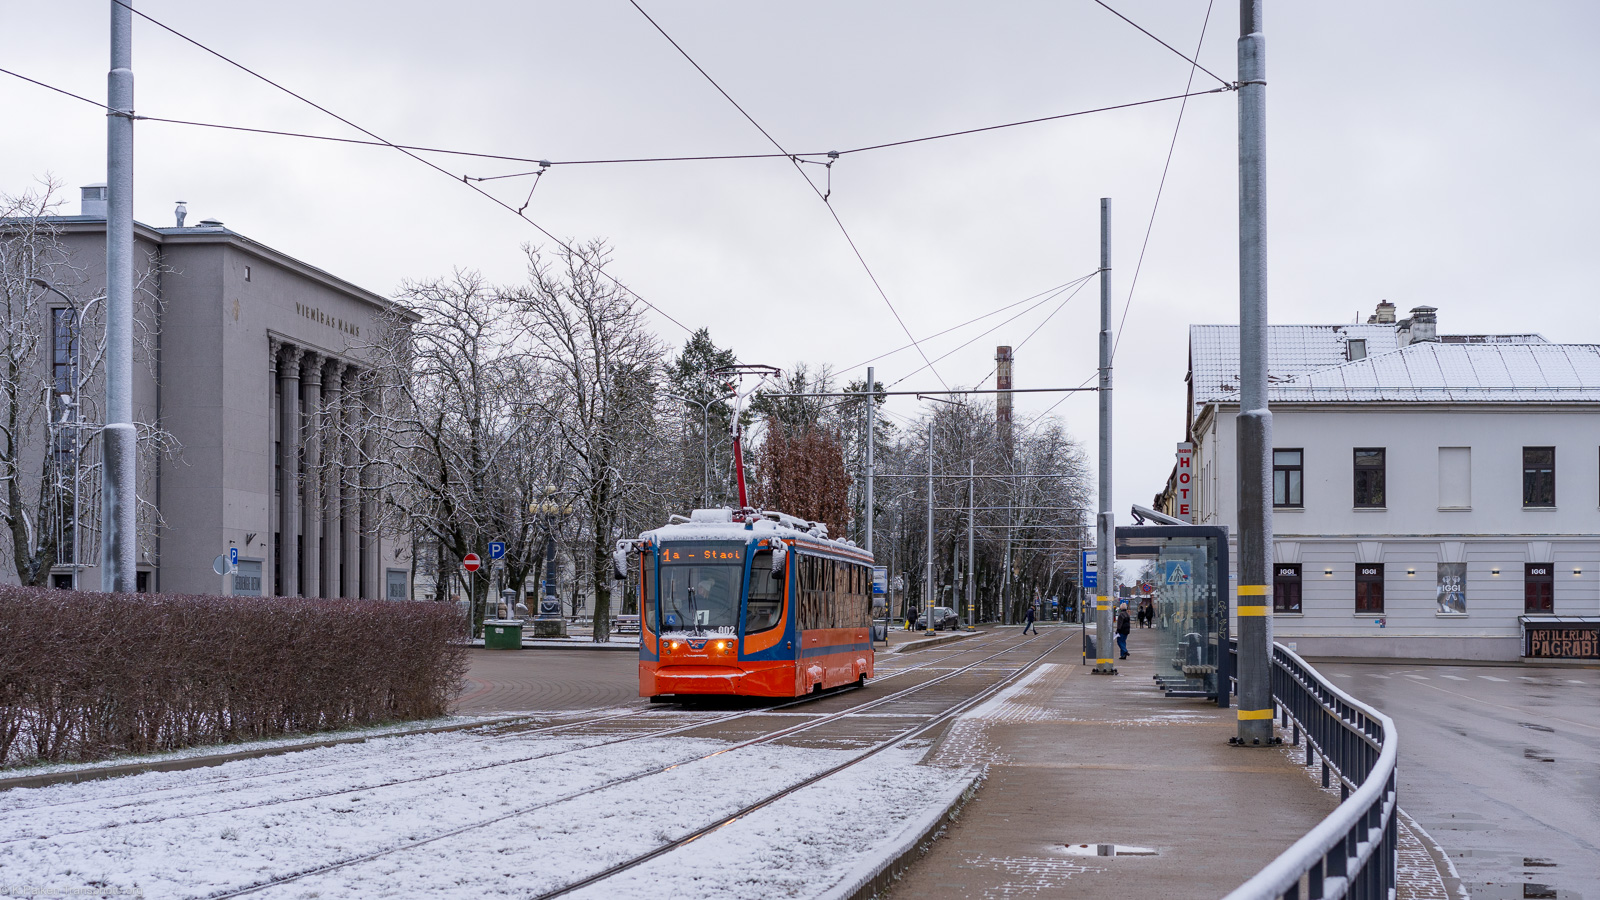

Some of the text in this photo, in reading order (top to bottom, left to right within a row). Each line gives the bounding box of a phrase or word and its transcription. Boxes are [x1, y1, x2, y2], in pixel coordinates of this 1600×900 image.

[338, 318, 359, 337] NAMS
[1179, 456, 1191, 521] HOTE
[492, 544, 501, 557] P
[663, 548, 680, 561] 1a
[1442, 584, 1460, 592] IGGI
[1531, 640, 1599, 656] PAGRABI
